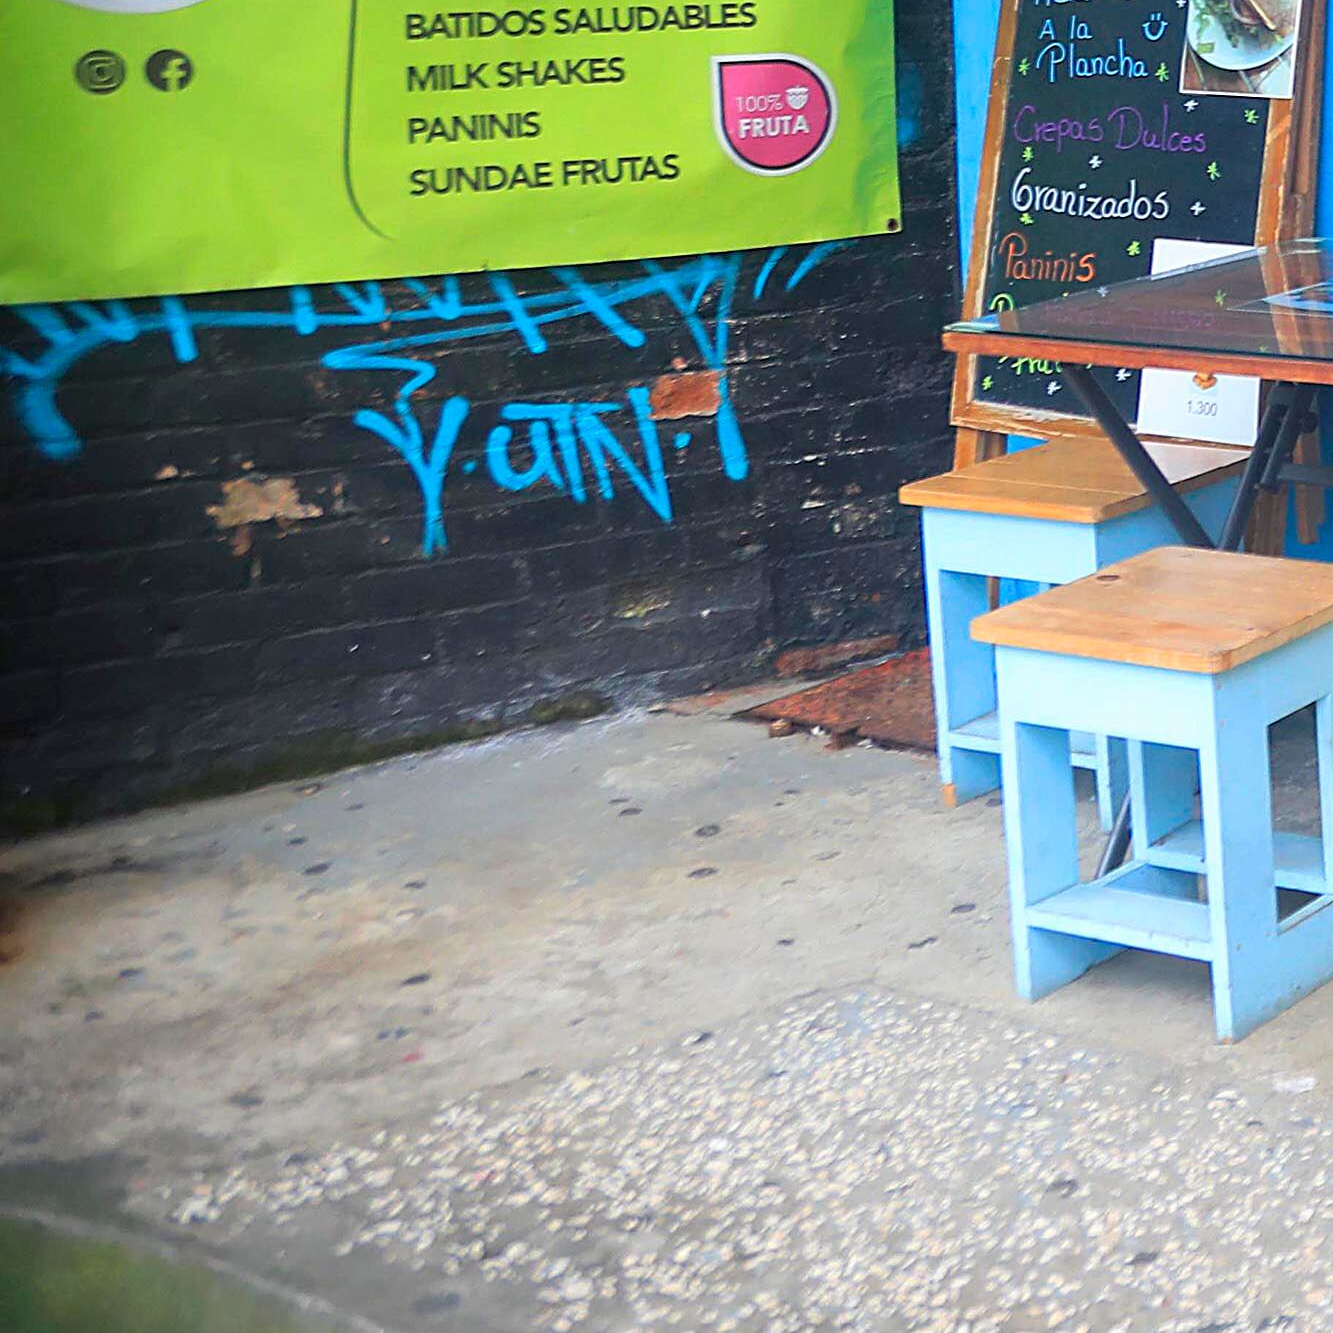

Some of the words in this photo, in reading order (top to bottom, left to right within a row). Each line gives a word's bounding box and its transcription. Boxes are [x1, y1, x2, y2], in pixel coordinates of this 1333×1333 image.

[405, 9, 546, 40] BATIDOS
[554, 2, 757, 34] SALUDABLES
[1039, 19, 1055, 41] A
[1069, 15, 1093, 41] la
[406, 63, 489, 92] MILK
[497, 57, 625, 87] SHAKES
[1035, 42, 1148, 83] Plancha
[736, 93, 782, 115] 100%
[407, 112, 541, 145] PANINIS
[738, 115, 811, 139] FRUTA
[1013, 104, 1105, 154] Crepas
[1107, 104, 1208, 154] Dulces
[409, 161, 554, 196] SUNDAE
[562, 154, 680, 187] FRUTAS
[1011, 167, 1170, 221] Granizados
[1000, 233, 1096, 284] Paninis
[1185, 399, 1218, 418] 1.300
